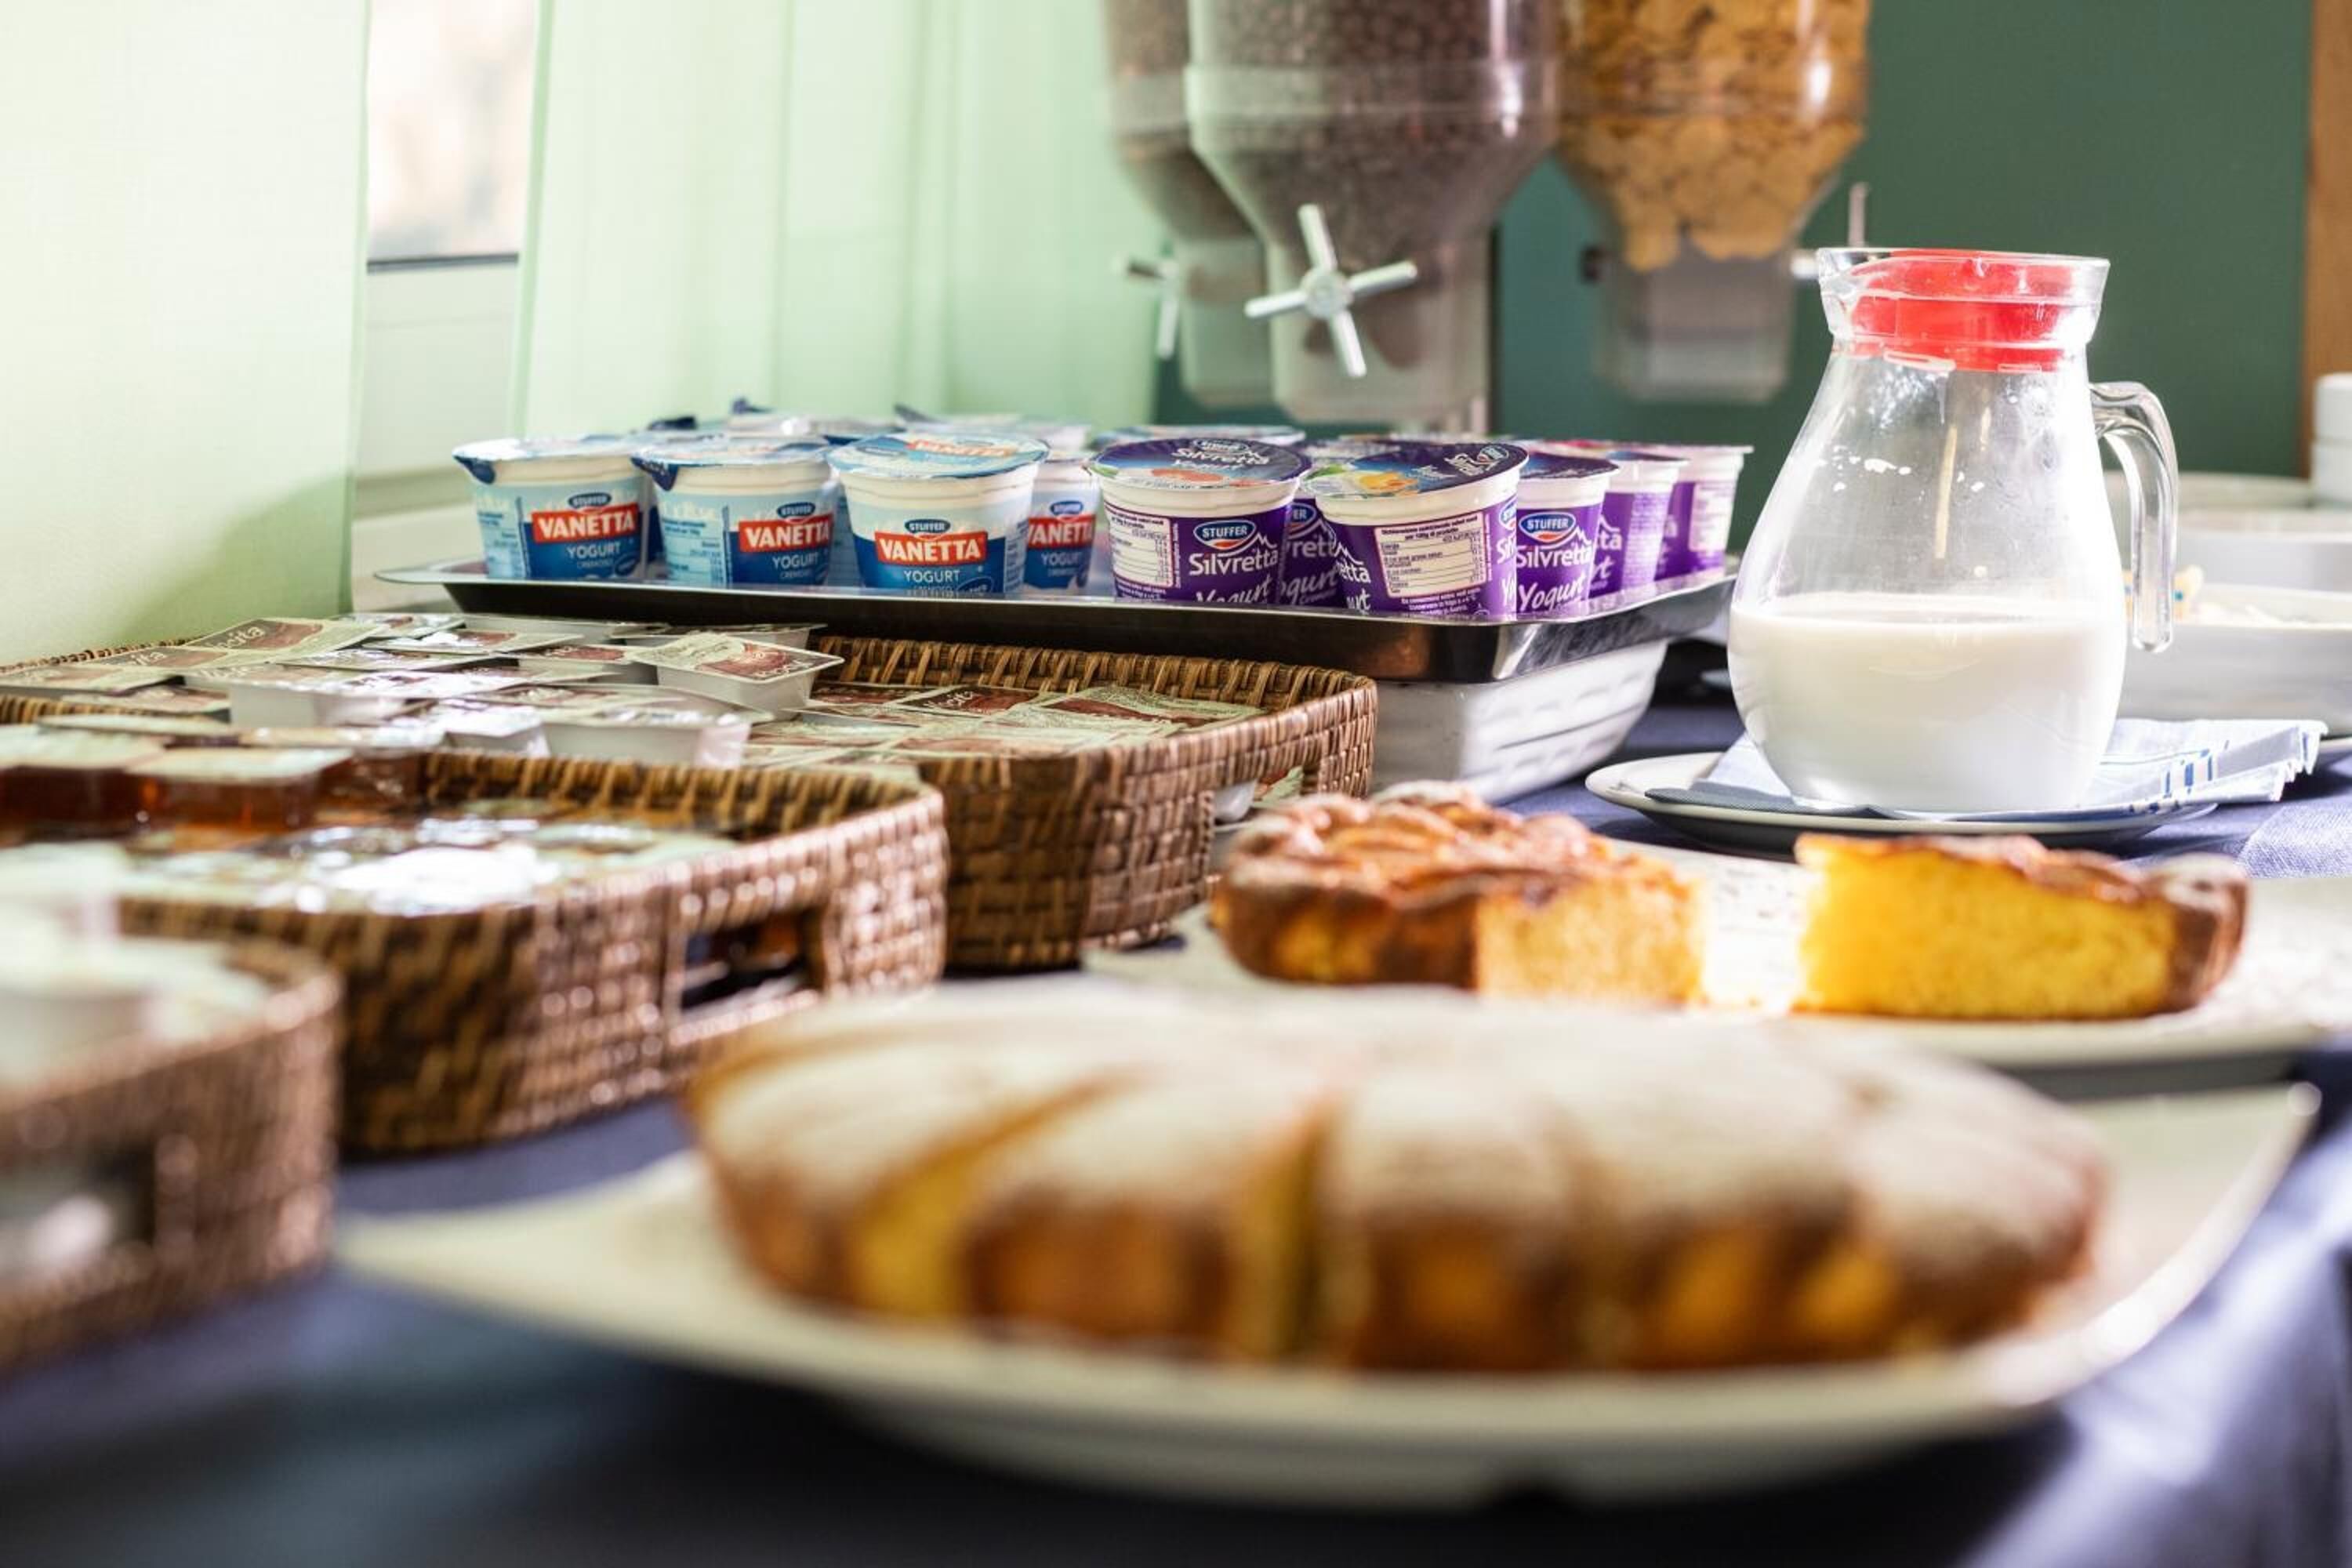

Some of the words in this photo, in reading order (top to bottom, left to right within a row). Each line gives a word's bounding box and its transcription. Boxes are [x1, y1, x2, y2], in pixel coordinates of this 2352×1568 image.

[538, 510, 635, 539] VANETTA
[909, 522, 946, 532] STUFFER
[1526, 517, 1569, 530] STUFFER
[1202, 525, 1248, 538] STUFFER
[565, 541, 622, 559] YOGURT
[878, 539, 981, 563] VANETTA
[1189, 548, 1279, 576] Silvretta
[904, 570, 961, 583] YOGURT
